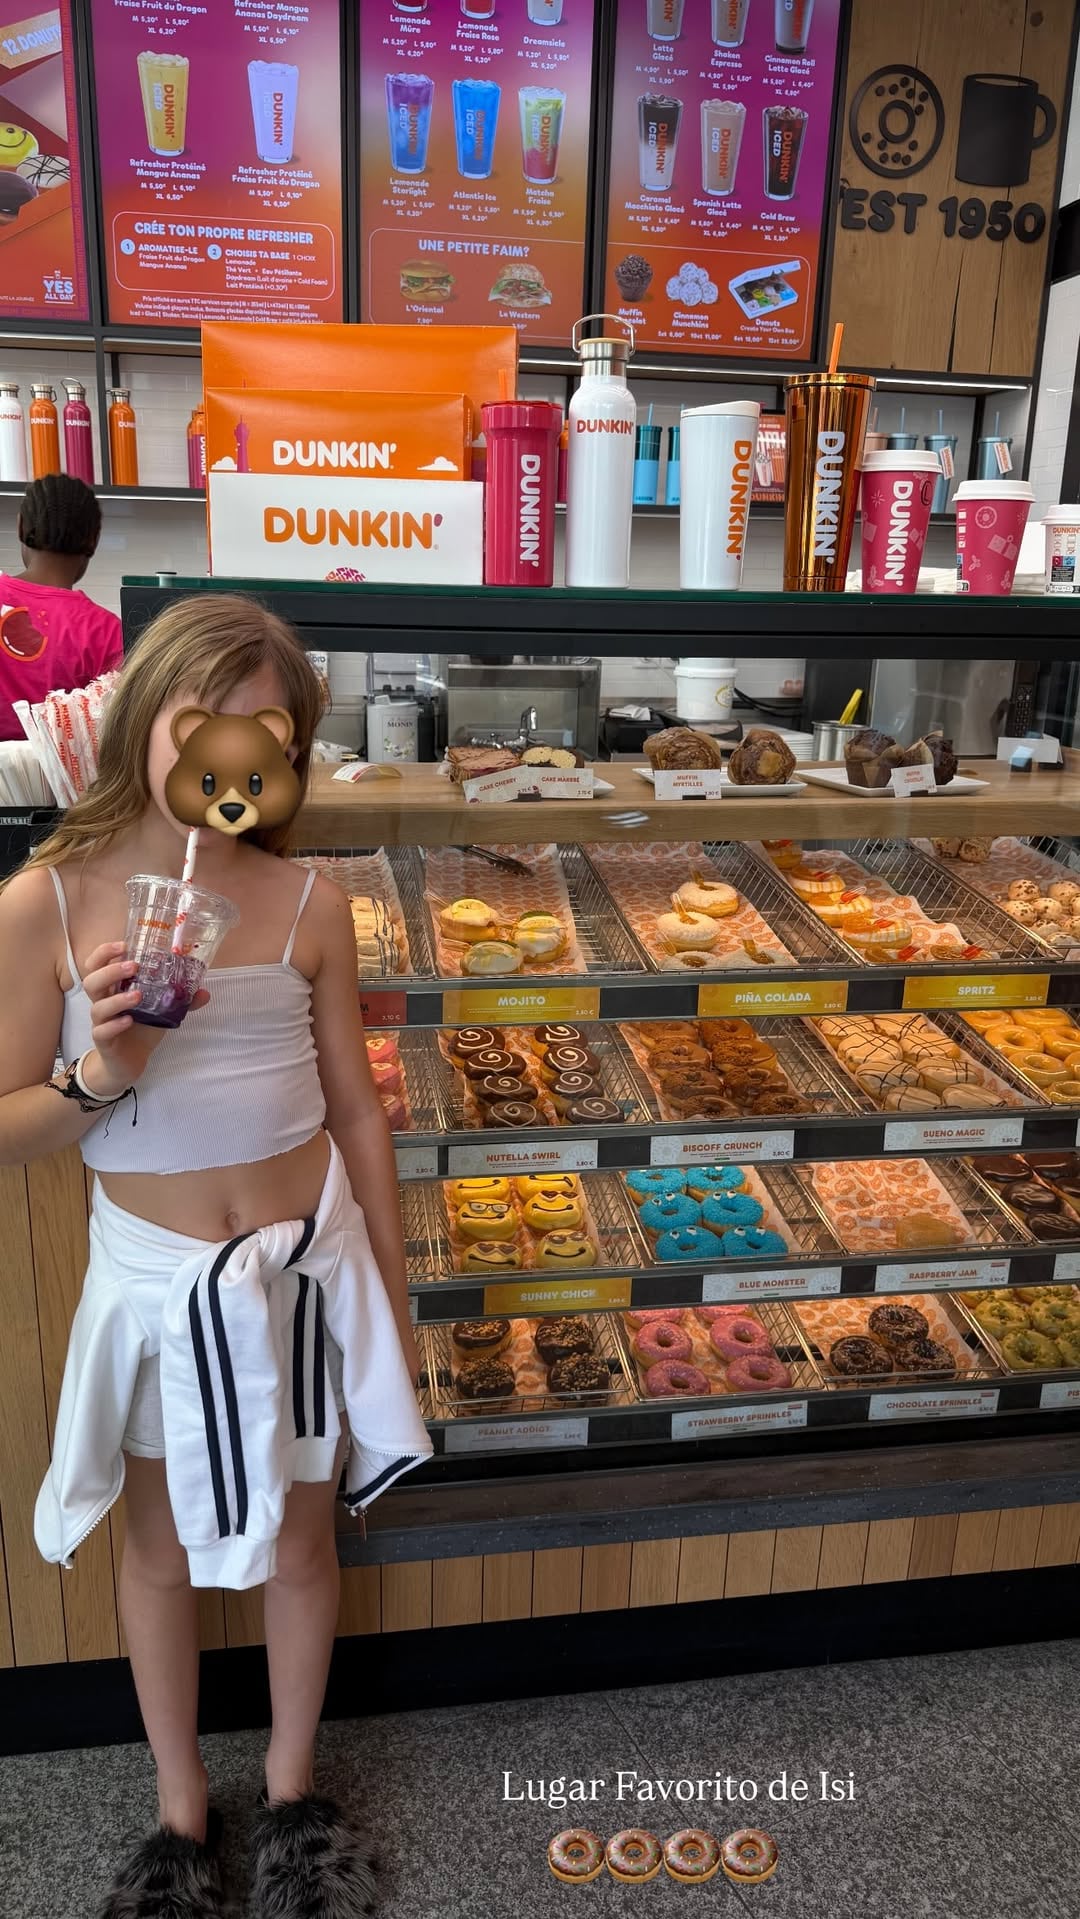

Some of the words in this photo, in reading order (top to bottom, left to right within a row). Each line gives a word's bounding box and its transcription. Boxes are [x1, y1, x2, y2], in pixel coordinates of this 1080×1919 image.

[142, 1, 162, 10] Fruit
[164, 2, 174, 10] du
[177, 3, 207, 14] Dragon
[234, 0, 275, 10] Refresher
[277, 3, 309, 13] Mangue
[235, 10, 266, 19] Ananas
[267, 12, 309, 22] Daydream
[390, 15, 431, 26] Lemonade
[400, 25, 421, 33] Mûre
[458, 21, 498, 32] Lemonade
[456, 31, 480, 40] Fraise
[481, 33, 499, 41] Rose
[523, 36, 566, 47] Dreamsicle
[2, 39, 20, 55] 12
[653, 44, 674, 53] Latte
[653, 52, 674, 61] Glacé
[714, 50, 741, 60] Shaken
[711, 58, 743, 68] Espresso
[765, 55, 801, 65] Cinnamon
[802, 58, 816, 67] Roll
[768, 64, 788, 73] Latte
[790, 65, 810, 75] Glacé
[164, 84, 175, 138] DUNKIN'
[399, 103, 408, 129] ICED
[273, 93, 283, 146] DUNKIN'
[466, 109, 474, 135] ICED
[649, 122, 657, 147] ICED
[712, 128, 720, 153] ICED
[773, 130, 782, 157] ICED
[656, 122, 668, 174] DUNKIN'
[719, 128, 731, 179] DUNKIN'
[779, 131, 792, 183] DUNKIN'
[130, 159, 170, 169] Refresher
[171, 161, 206, 171] Protéiné
[136, 168, 169, 178] Mangue
[170, 171, 200, 180] Ananas
[238, 166, 277, 177] Refresher
[279, 168, 313, 178] Protéiné
[232, 175, 256, 183] Fraise
[258, 177, 277, 185] Fruit
[279, 178, 289, 186] du
[290, 178, 320, 188] Dragon
[390, 178, 429, 187] Lemonade
[453, 191, 484, 200] Atlantic
[526, 188, 554, 197] Matcha
[528, 197, 551, 205] Fraise
[640, 195, 671, 203] Caramel
[693, 199, 720, 209] Spanish
[722, 201, 742, 209] Latte
[625, 202, 663, 212] Macchiato
[665, 205, 685, 214] Glacé
[707, 208, 727, 216] Glacé
[760, 212, 776, 220] Cold
[778, 214, 796, 222] Brew
[841, 188, 927, 234] EST
[939, 196, 1046, 243] 1950
[134, 220, 165, 235] CRÉE
[169, 225, 195, 237] TON
[197, 226, 244, 240] PROPRE
[248, 229, 313, 244] REFRESHER
[139, 244, 198, 255] AROMATISE-LE
[419, 240, 444, 252] UNE
[447, 242, 489, 255] PETITE
[493, 245, 530, 257] FAIM?
[225, 249, 257, 259] CHOISIS
[259, 251, 269, 259] TA
[271, 252, 290, 260] BASE
[43, 280, 73, 294] YES
[406, 304, 444, 313] L'Oriental
[618, 308, 643, 316] Muffin
[509, 311, 540, 319] Western
[673, 312, 709, 321] Cinnamon
[672, 319, 709, 329] Munchkins
[755, 319, 780, 327] Donuts
[576, 419, 634, 435] DUNKIN'
[272, 440, 397, 470] DUNKIN'
[726, 440, 752, 561] DUNKIN'
[814, 431, 846, 564] DUNKIN'
[520, 454, 541, 568] DUNKIN'
[263, 506, 443, 550] DUNKIN'
[884, 480, 914, 587] DUNKIN'
[479, 783, 493, 792] CAKE
[495, 778, 516, 788] CHERRY
[958, 986, 995, 996] SPRITZ
[498, 996, 545, 1006] MOJITO
[735, 991, 762, 1004] PIÑA
[765, 992, 812, 1003] COLADA
[923, 1129, 952, 1138] BUENO
[955, 1128, 985, 1137] MAGIC
[682, 1143, 721, 1153] BISCOFF
[724, 1141, 763, 1151] CRUNCH
[486, 1153, 529, 1162] NUTELLA
[531, 1151, 561, 1160] SWIRL
[909, 1270, 956, 1280] RASPBERRY
[958, 1269, 978, 1278] JAM
[738, 1280, 762, 1289] BLUE
[763, 1278, 806, 1288] MONSTER
[520, 1292, 559, 1301] SUNNY
[561, 1290, 597, 1299] CHICK
[886, 1400, 937, 1409] CHOCOLATE
[687, 1417, 744, 1428] STRAWBERRY
[746, 1411, 793, 1421] SPRINKLES
[478, 1428, 514, 1436] PEANUT
[516, 1426, 550, 1434] ADDICT
